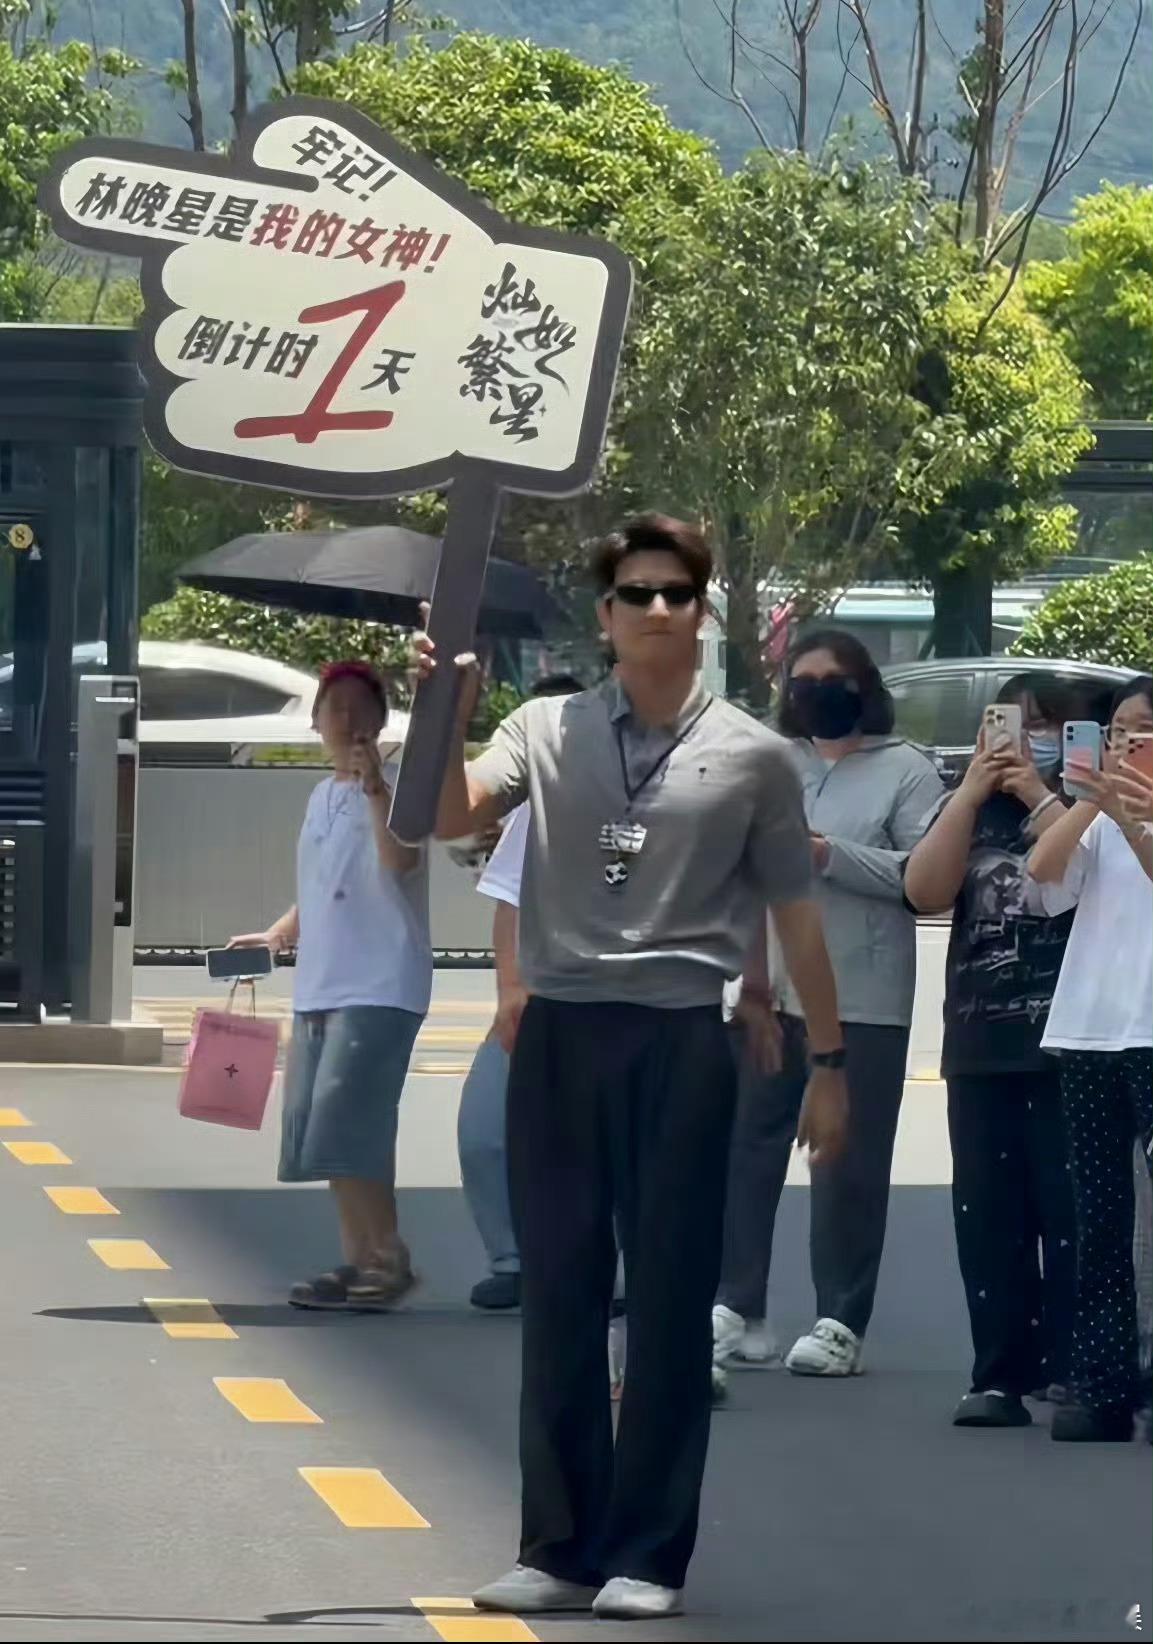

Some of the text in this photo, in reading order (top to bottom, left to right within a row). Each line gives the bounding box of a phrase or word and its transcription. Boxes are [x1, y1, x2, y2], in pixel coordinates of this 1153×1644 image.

[291, 125, 398, 202] 牢记!
[74, 171, 451, 274] 林晚星是我的女神!
